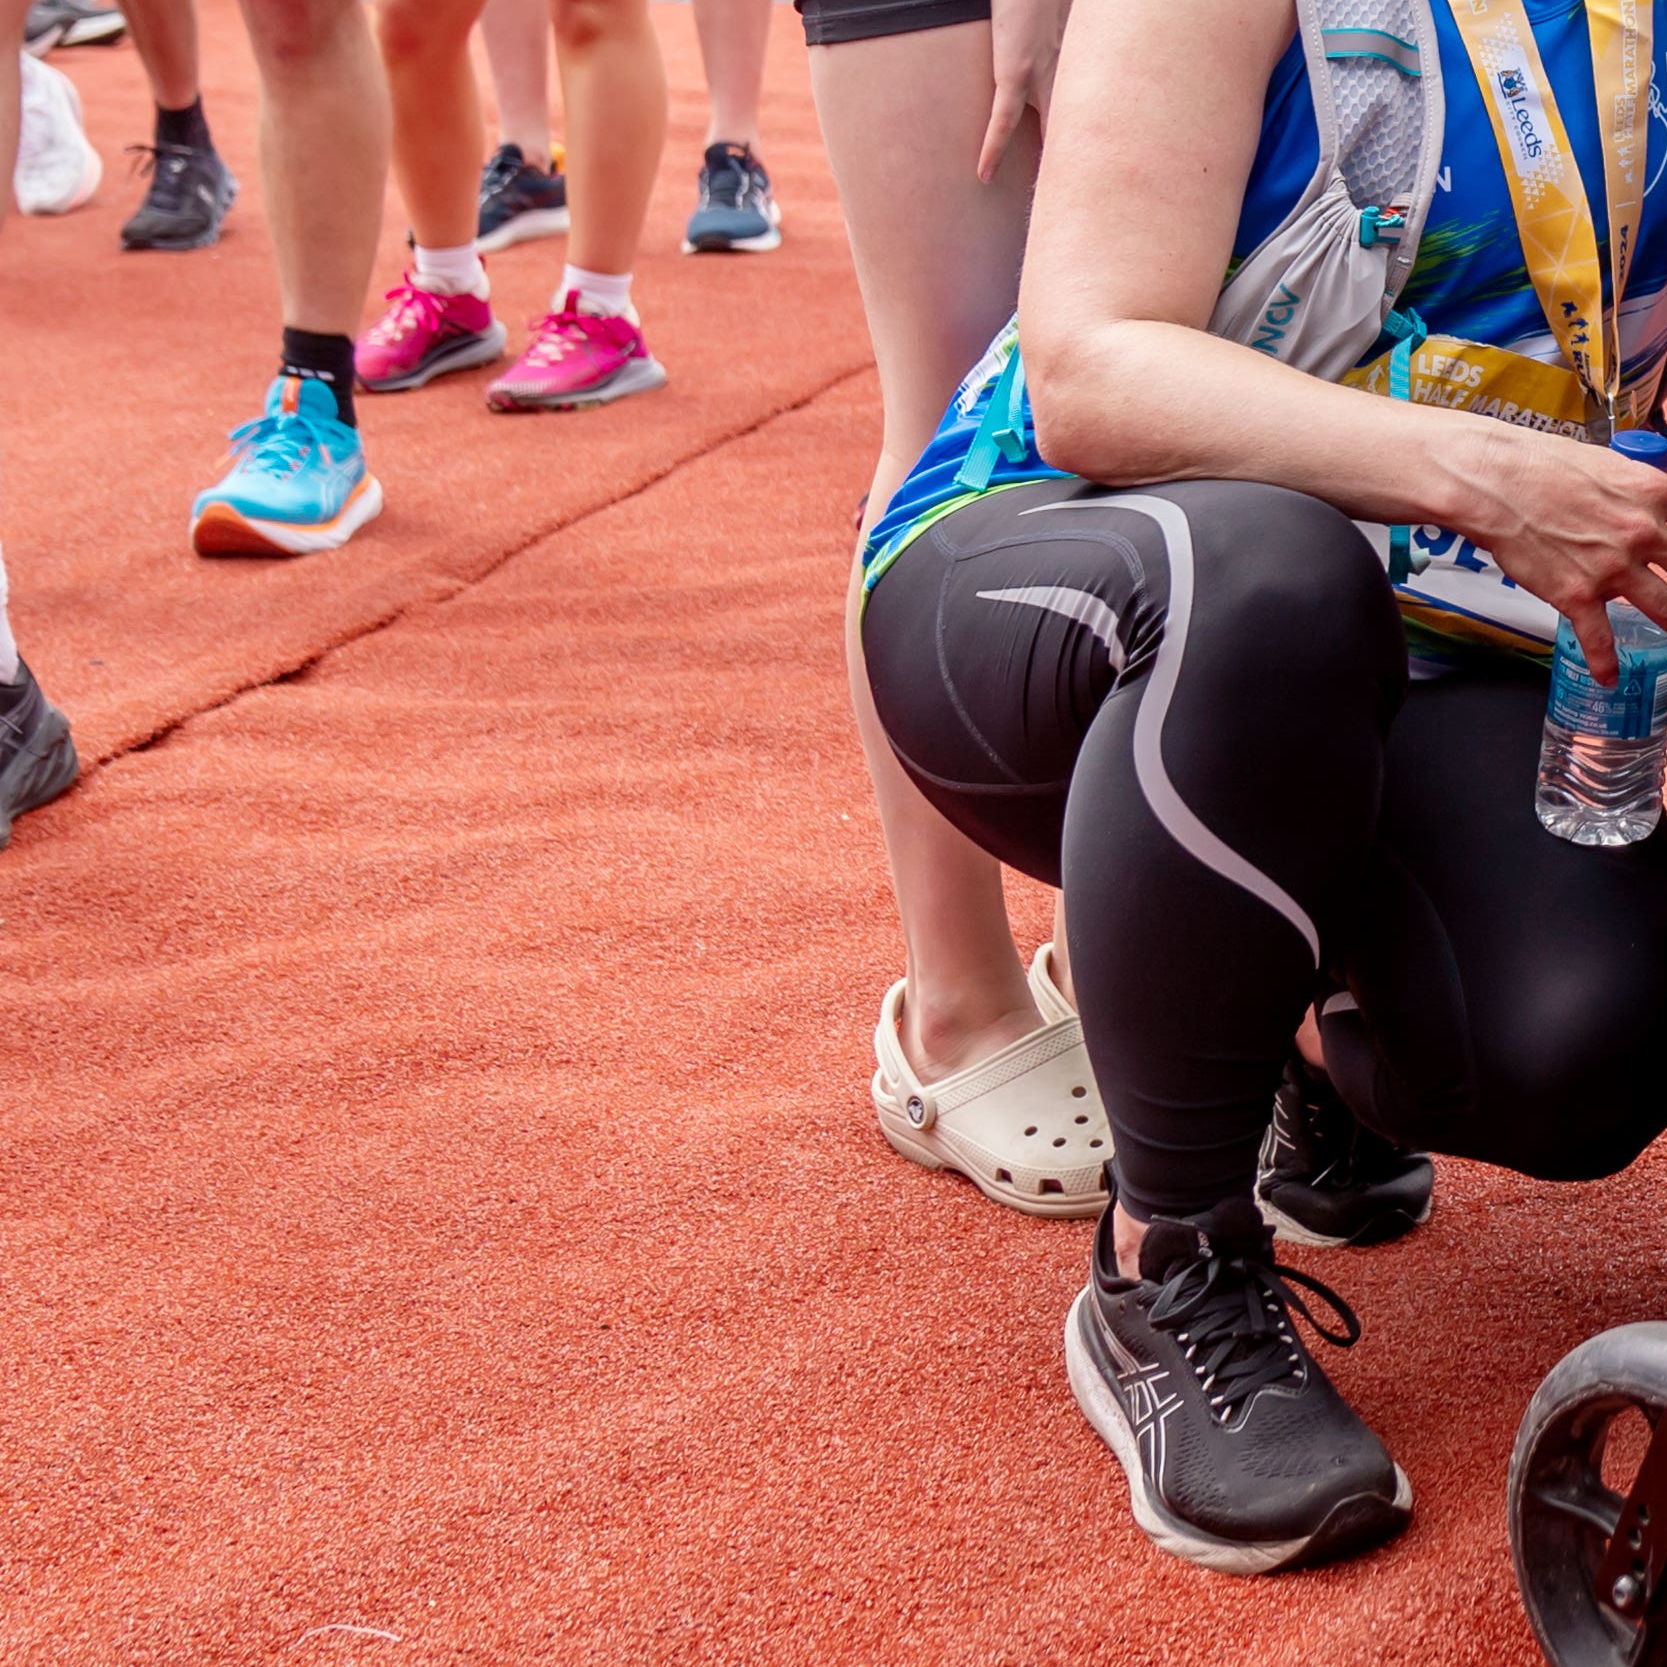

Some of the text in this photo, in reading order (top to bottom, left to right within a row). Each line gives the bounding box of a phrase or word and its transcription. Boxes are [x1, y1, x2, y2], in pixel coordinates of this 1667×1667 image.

[1621, 0, 1638, 95] MARATHON
[1512, 95, 1542, 159] Leeds
[1413, 379, 1469, 409] HALF
[1418, 353, 1485, 388] LEEDS
